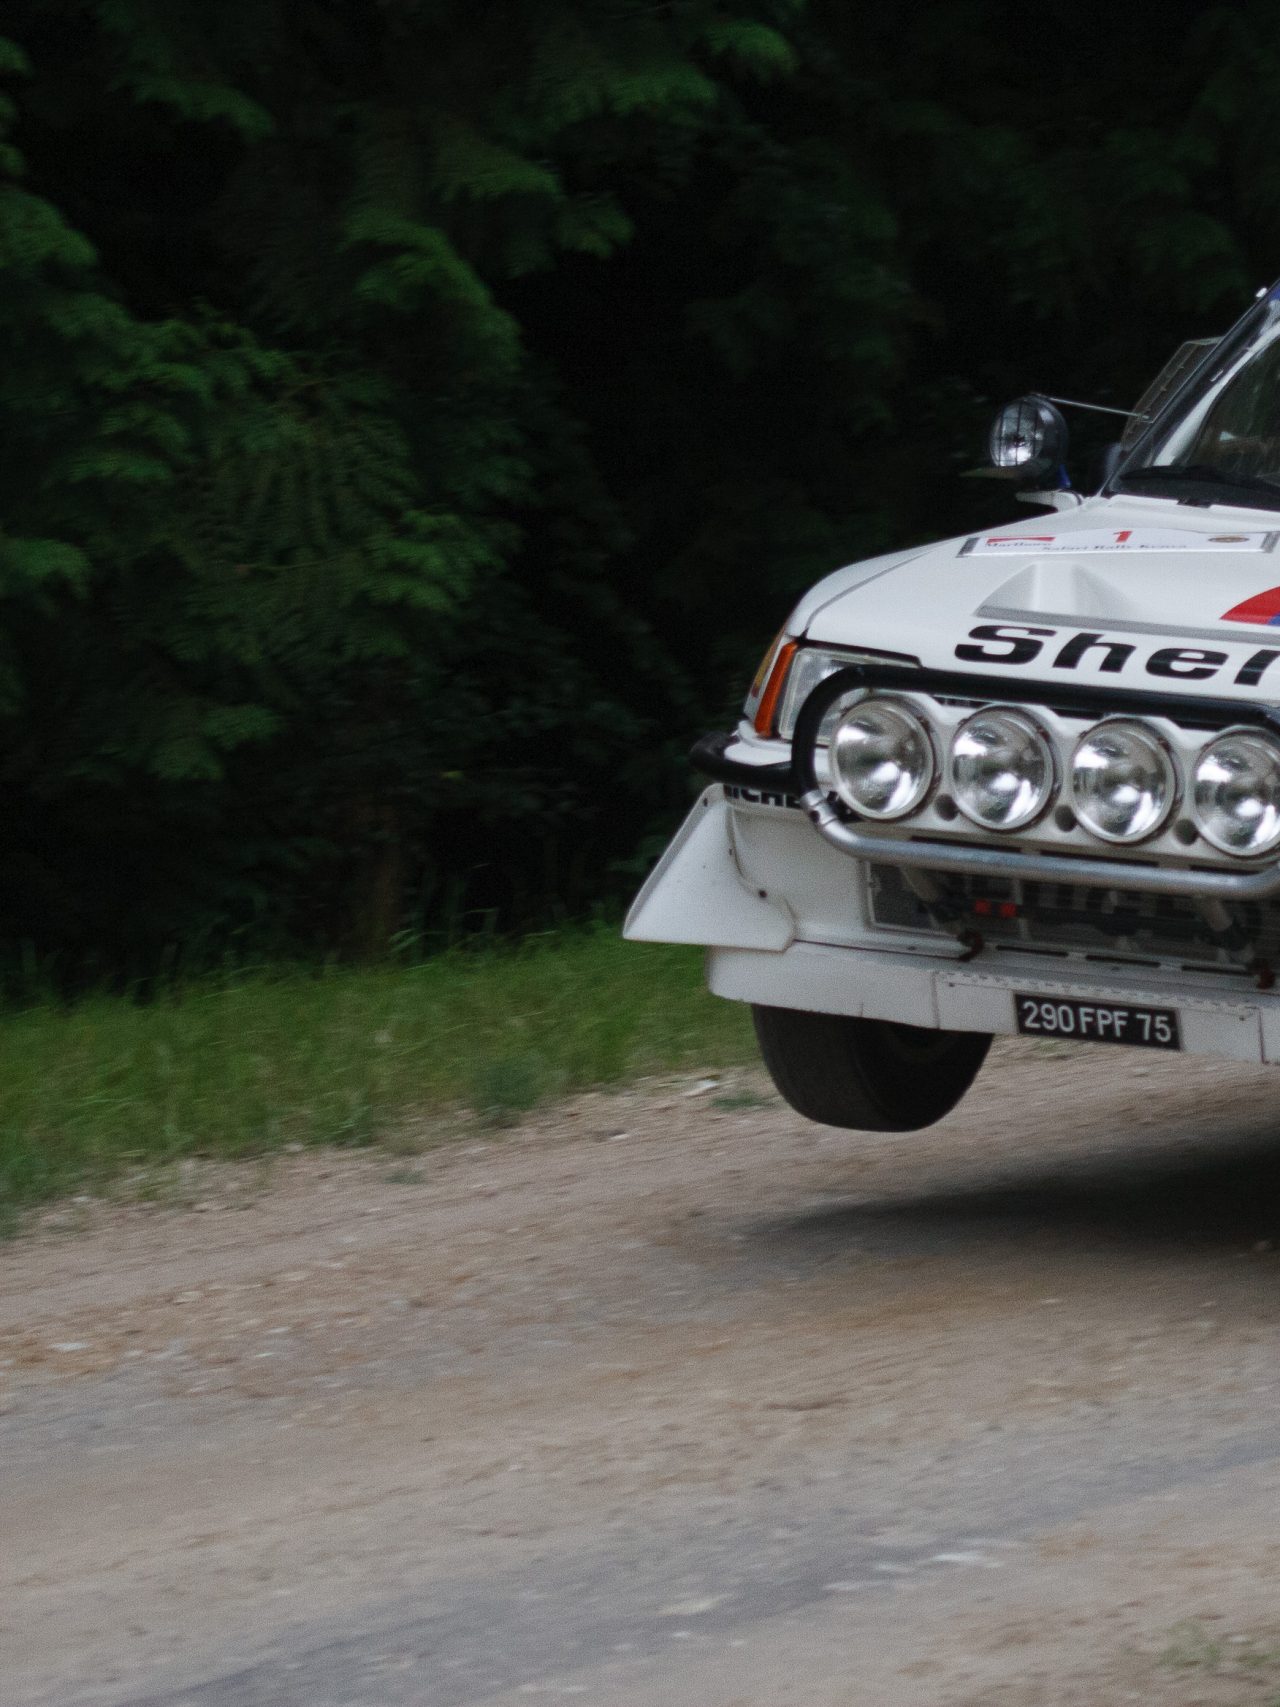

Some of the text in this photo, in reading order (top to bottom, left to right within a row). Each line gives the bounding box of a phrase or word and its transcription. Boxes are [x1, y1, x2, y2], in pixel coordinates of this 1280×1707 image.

[1112, 530, 1134, 543] 1
[1022, 1001, 1172, 1042] 290 FPF 75
